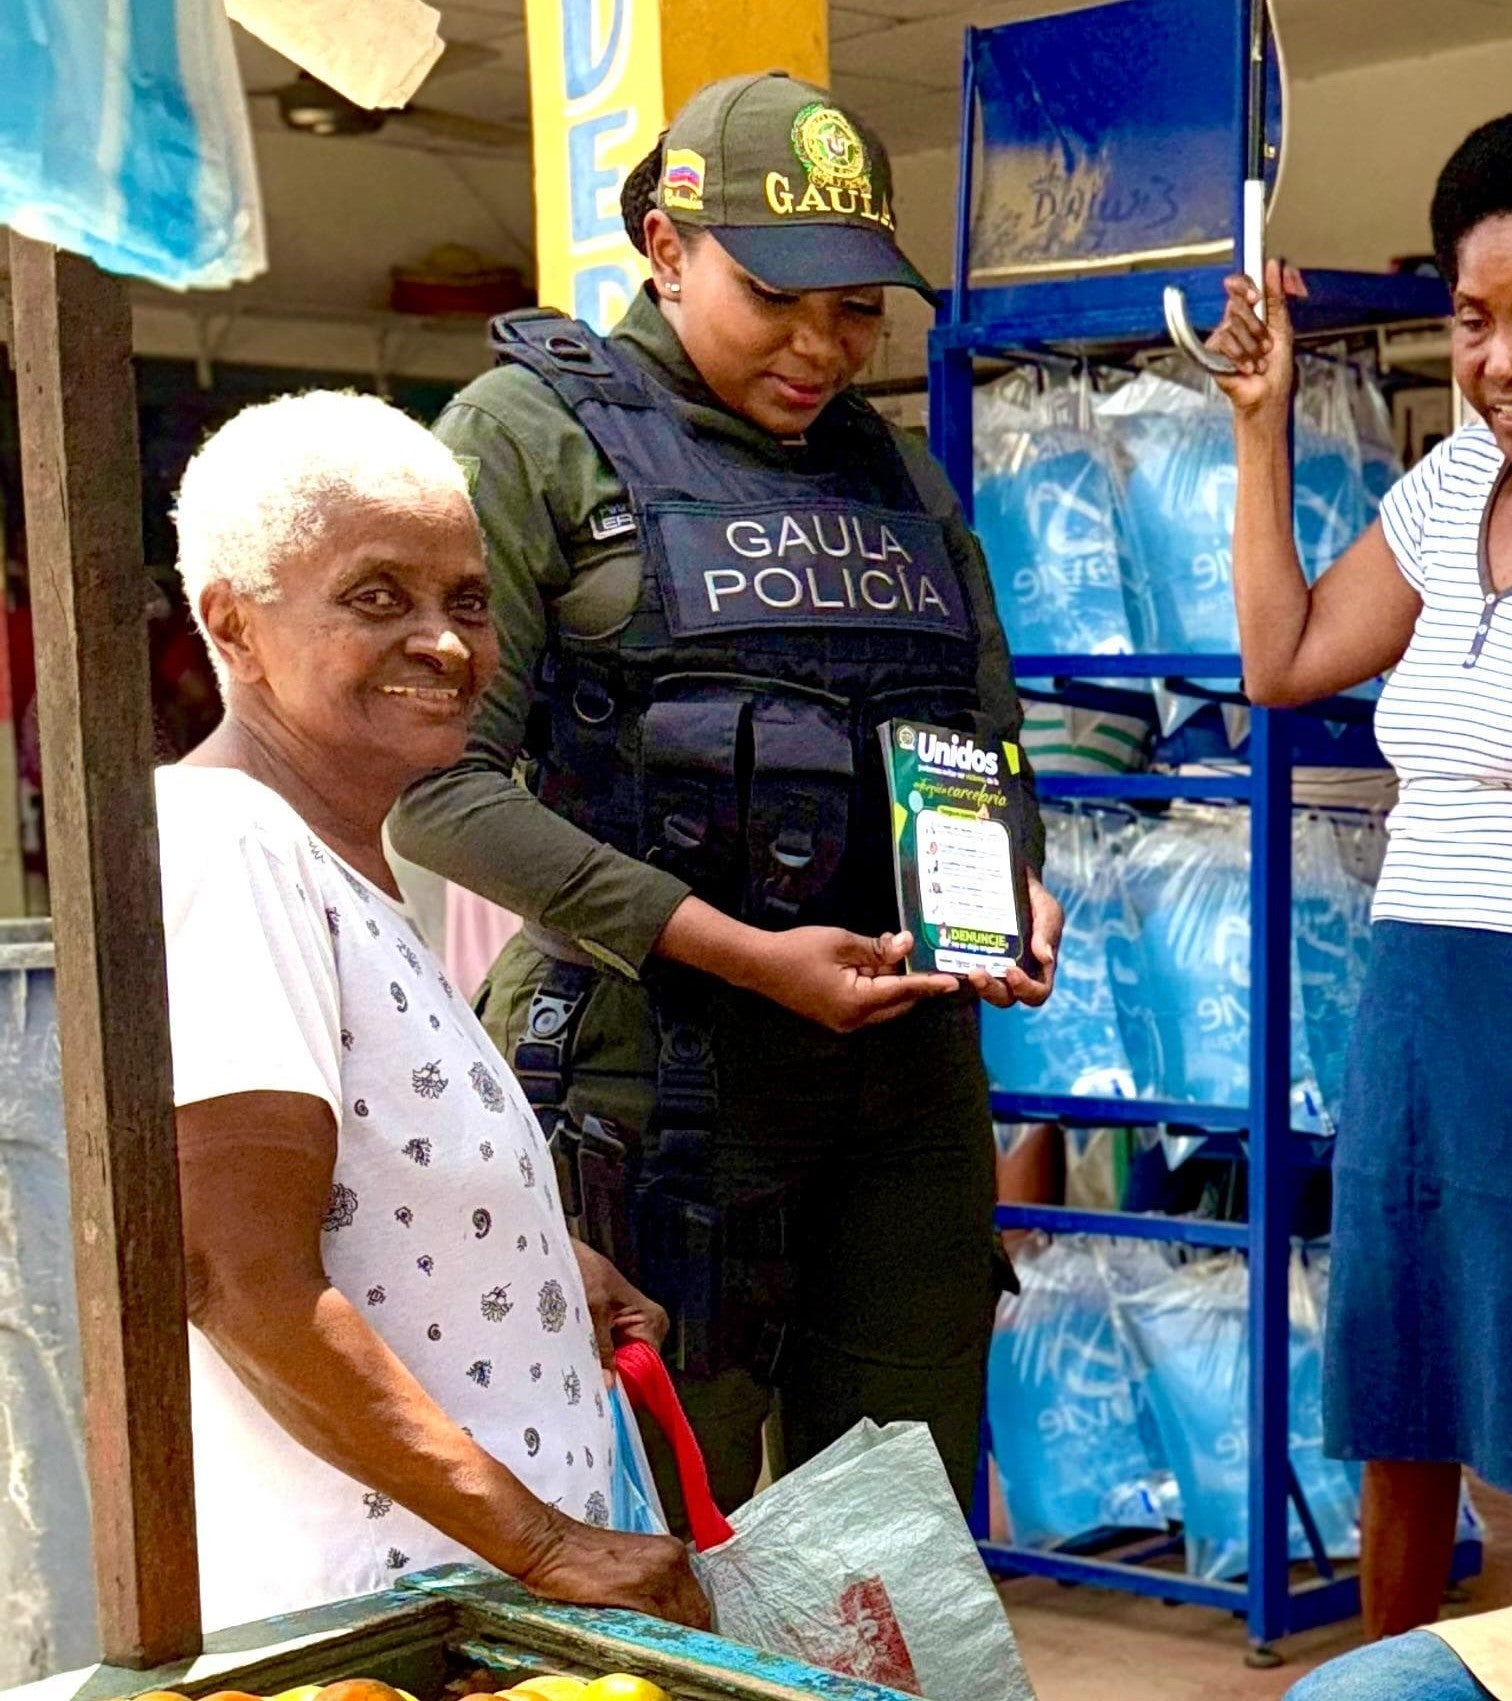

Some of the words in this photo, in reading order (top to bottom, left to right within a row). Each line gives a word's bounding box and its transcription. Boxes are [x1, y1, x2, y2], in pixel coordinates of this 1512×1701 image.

[725, 514, 913, 564] GAULA
[703, 564, 950, 616] POLICÍA
[917, 732, 999, 776] Unidos
